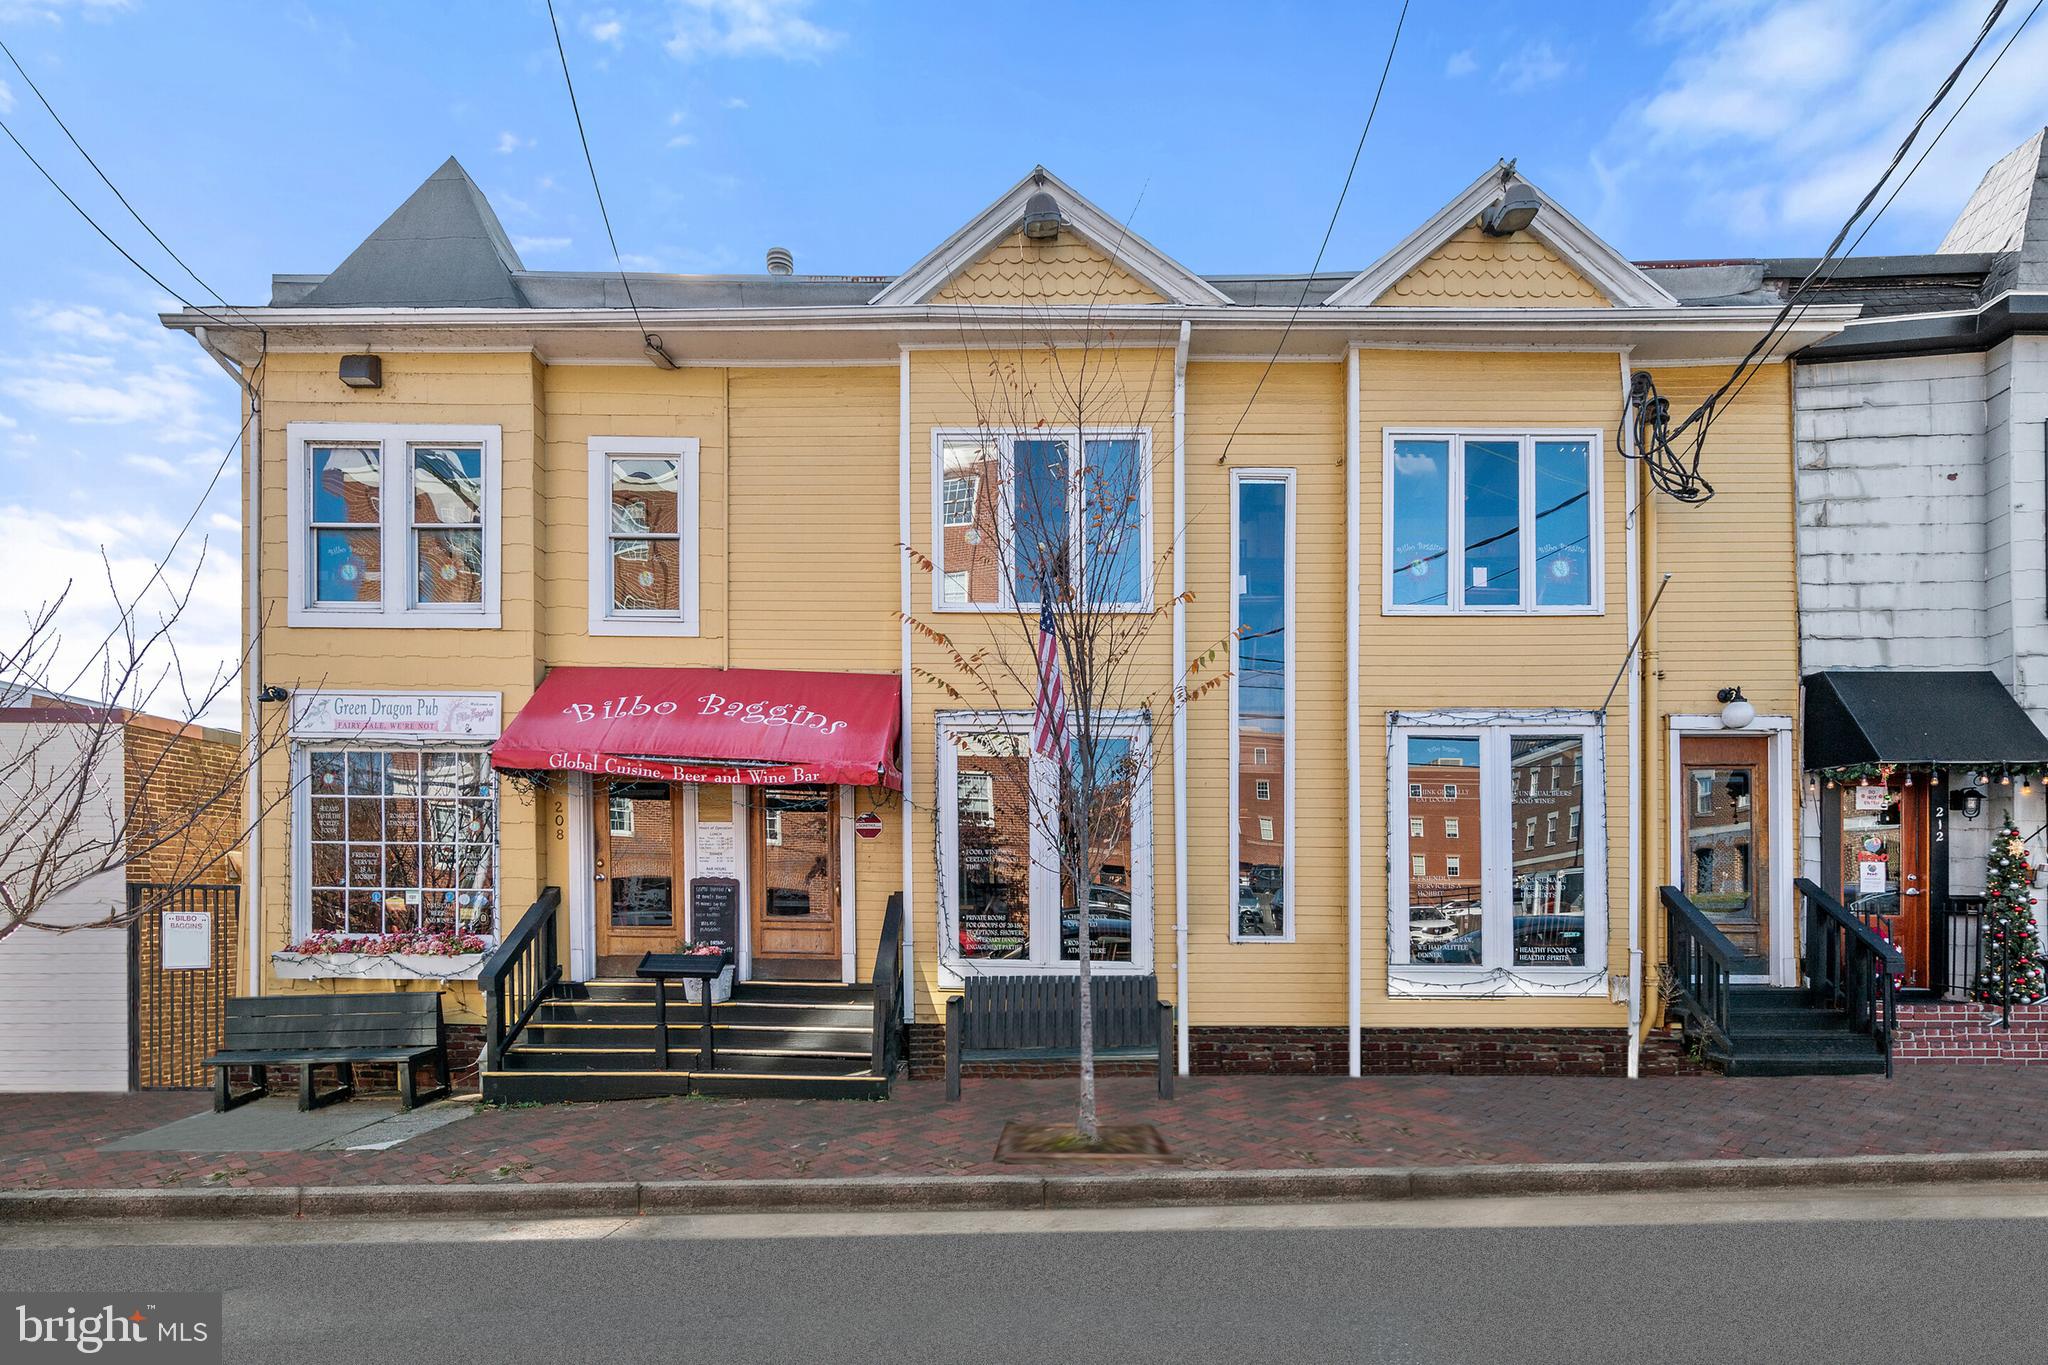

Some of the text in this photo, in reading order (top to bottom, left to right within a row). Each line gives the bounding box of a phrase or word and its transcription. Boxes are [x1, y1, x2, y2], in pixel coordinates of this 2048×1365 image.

[334, 697, 439, 719] Green Dragon Pub
[563, 693, 848, 735] Bilbo Baggins
[549, 752, 820, 784] Global Cuisine, Beer and Wine Bar
[554, 801, 564, 840] 208
[1935, 806, 1945, 842] 212
